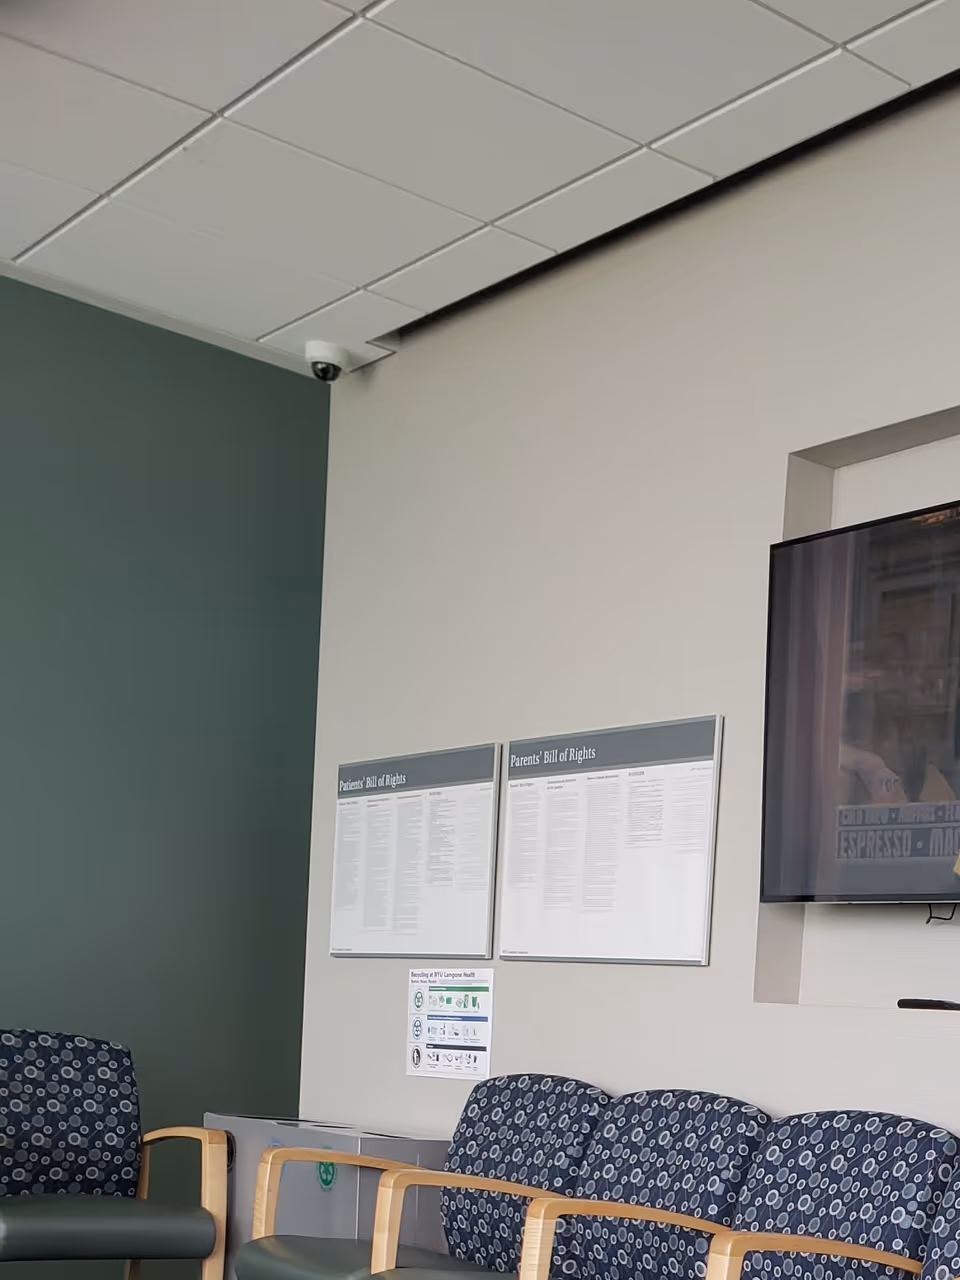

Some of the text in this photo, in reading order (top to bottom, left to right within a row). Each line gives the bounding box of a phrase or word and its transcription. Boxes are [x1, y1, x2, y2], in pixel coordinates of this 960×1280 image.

[510, 745, 596, 768] Parents' Bill of Rights
[339, 773, 407, 791] Patients' Bill of Rights
[840, 830, 912, 859] ESPRESSO
